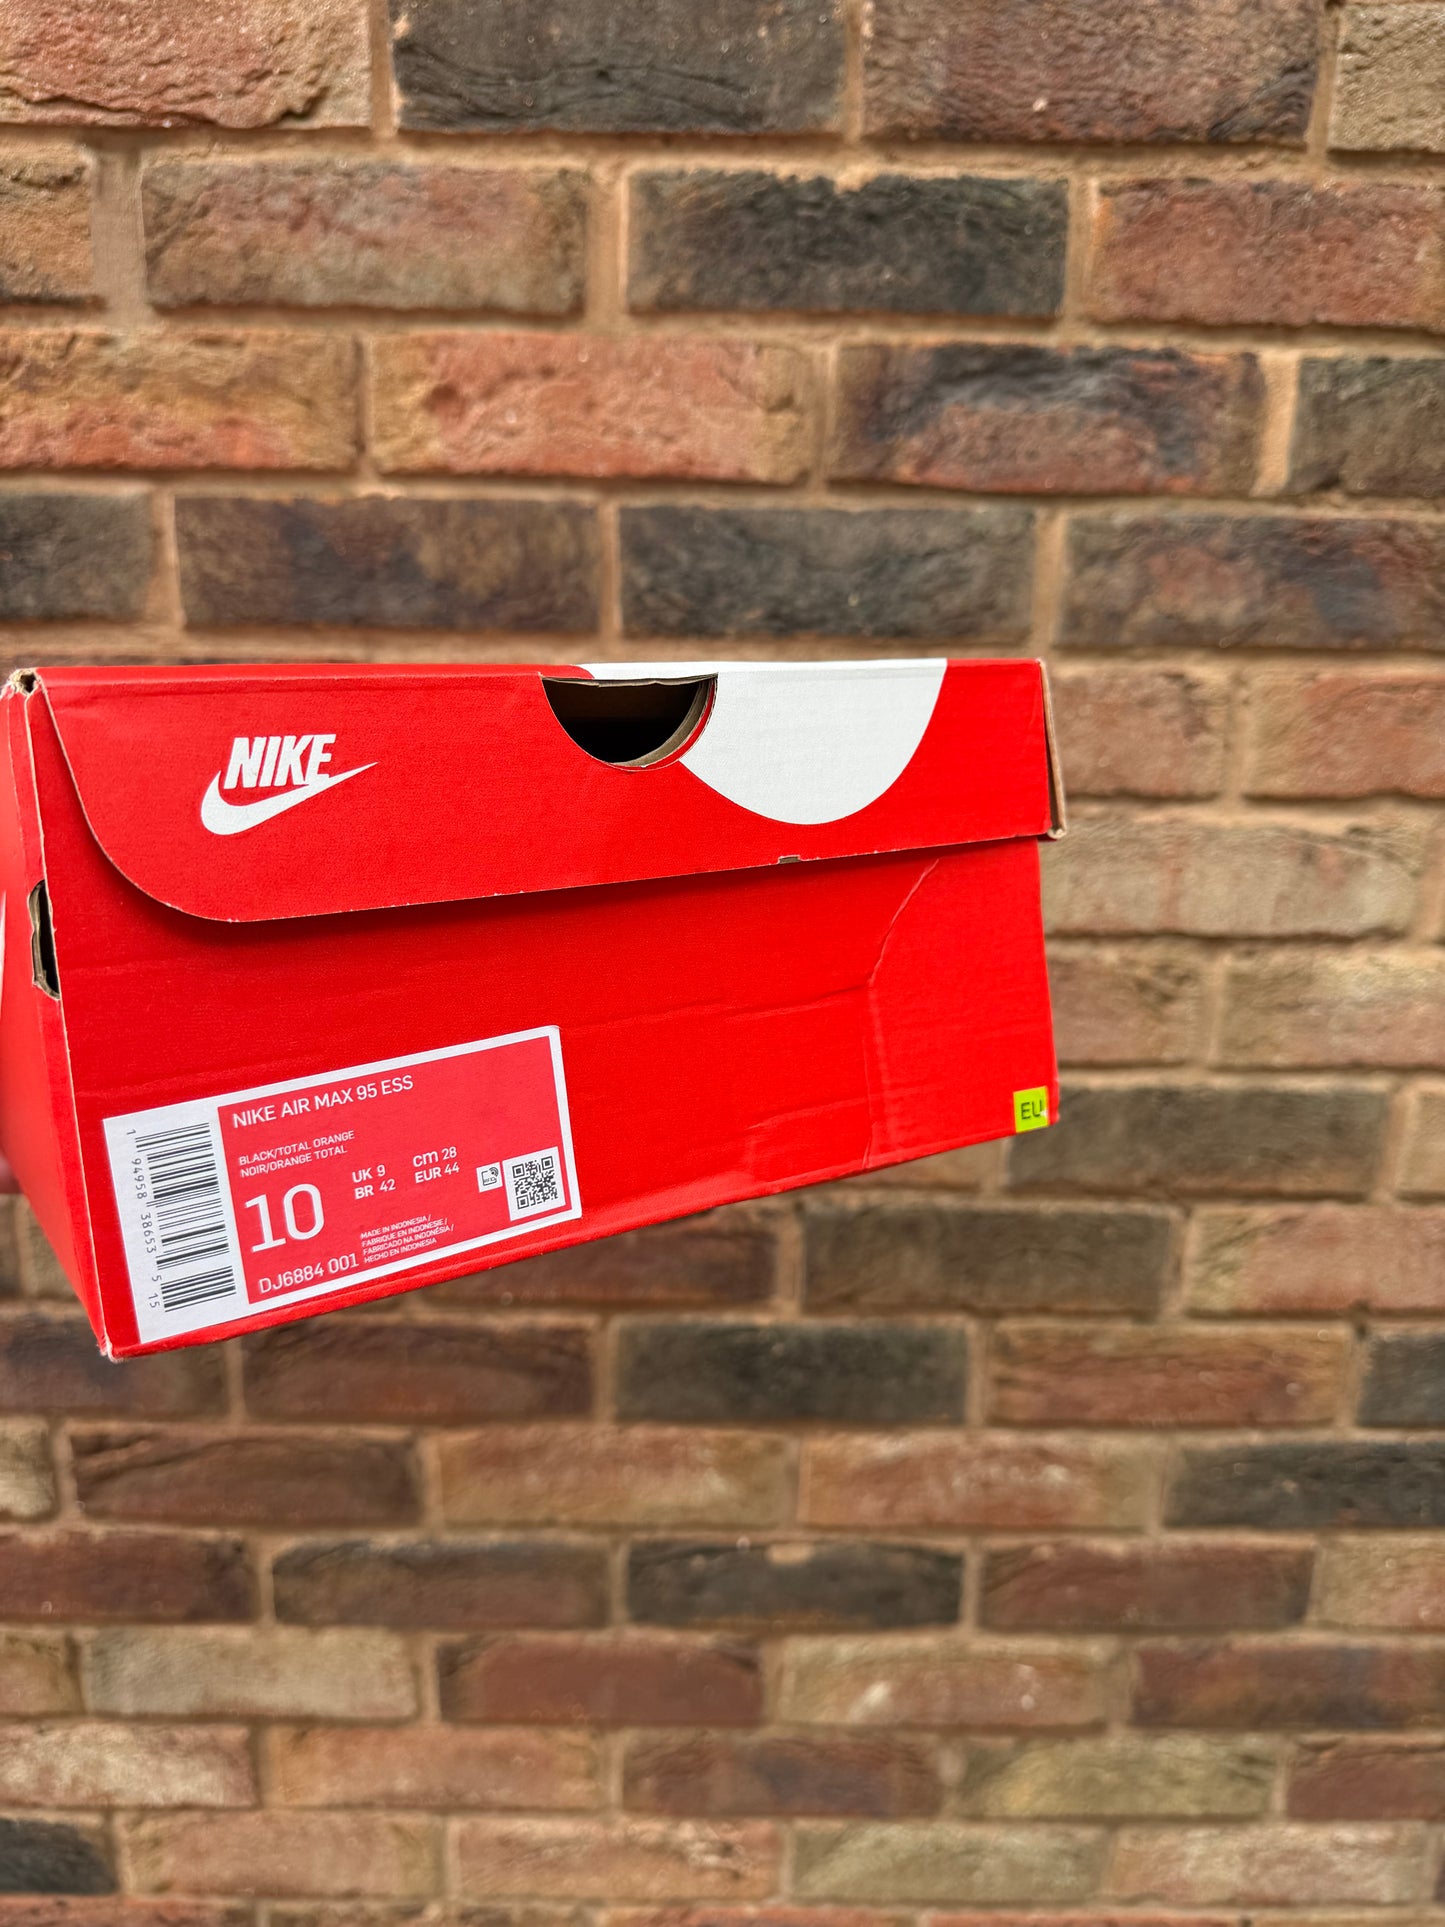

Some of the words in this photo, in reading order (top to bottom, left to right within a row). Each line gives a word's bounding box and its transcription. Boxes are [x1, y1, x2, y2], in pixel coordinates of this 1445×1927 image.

[223, 734, 336, 789] NIKE
[232, 1105, 277, 1128] NIKE
[281, 1098, 311, 1118] AIR
[314, 1088, 354, 1110] MAX
[356, 1082, 378, 1100] 95
[381, 1075, 414, 1095] ESS
[1020, 1099, 1042, 1120] EU
[238, 1142, 312, 1166] BLACK/TOTAL
[313, 1130, 355, 1148] ORANGE
[441, 1146, 458, 1160] 28
[240, 1154, 312, 1178] NOIR/ORANGE
[315, 1145, 348, 1160] TOTAL
[352, 1167, 373, 1183] UK
[376, 1164, 386, 1177] 9
[414, 1166, 442, 1184] EUR
[444, 1162, 460, 1175] 44
[131, 1158, 147, 1199] 94958
[354, 1185, 375, 1200] BR
[379, 1178, 396, 1192] 42
[244, 1183, 325, 1253] 10
[360, 1227, 382, 1239] MADE
[382, 1225, 390, 1233] IN
[391, 1215, 427, 1231] INDONESIA
[140, 1213, 157, 1253] 38653
[363, 1239, 402, 1255] FABRICADO
[403, 1236, 414, 1244] NA
[397, 1230, 407, 1238] EN
[364, 1250, 389, 1264] HECHO
[390, 1247, 400, 1256] EN
[400, 1237, 437, 1253] INDONESIA
[258, 1262, 324, 1294] DJ6884
[327, 1253, 359, 1274] 001
[148, 1293, 160, 1308] 15
